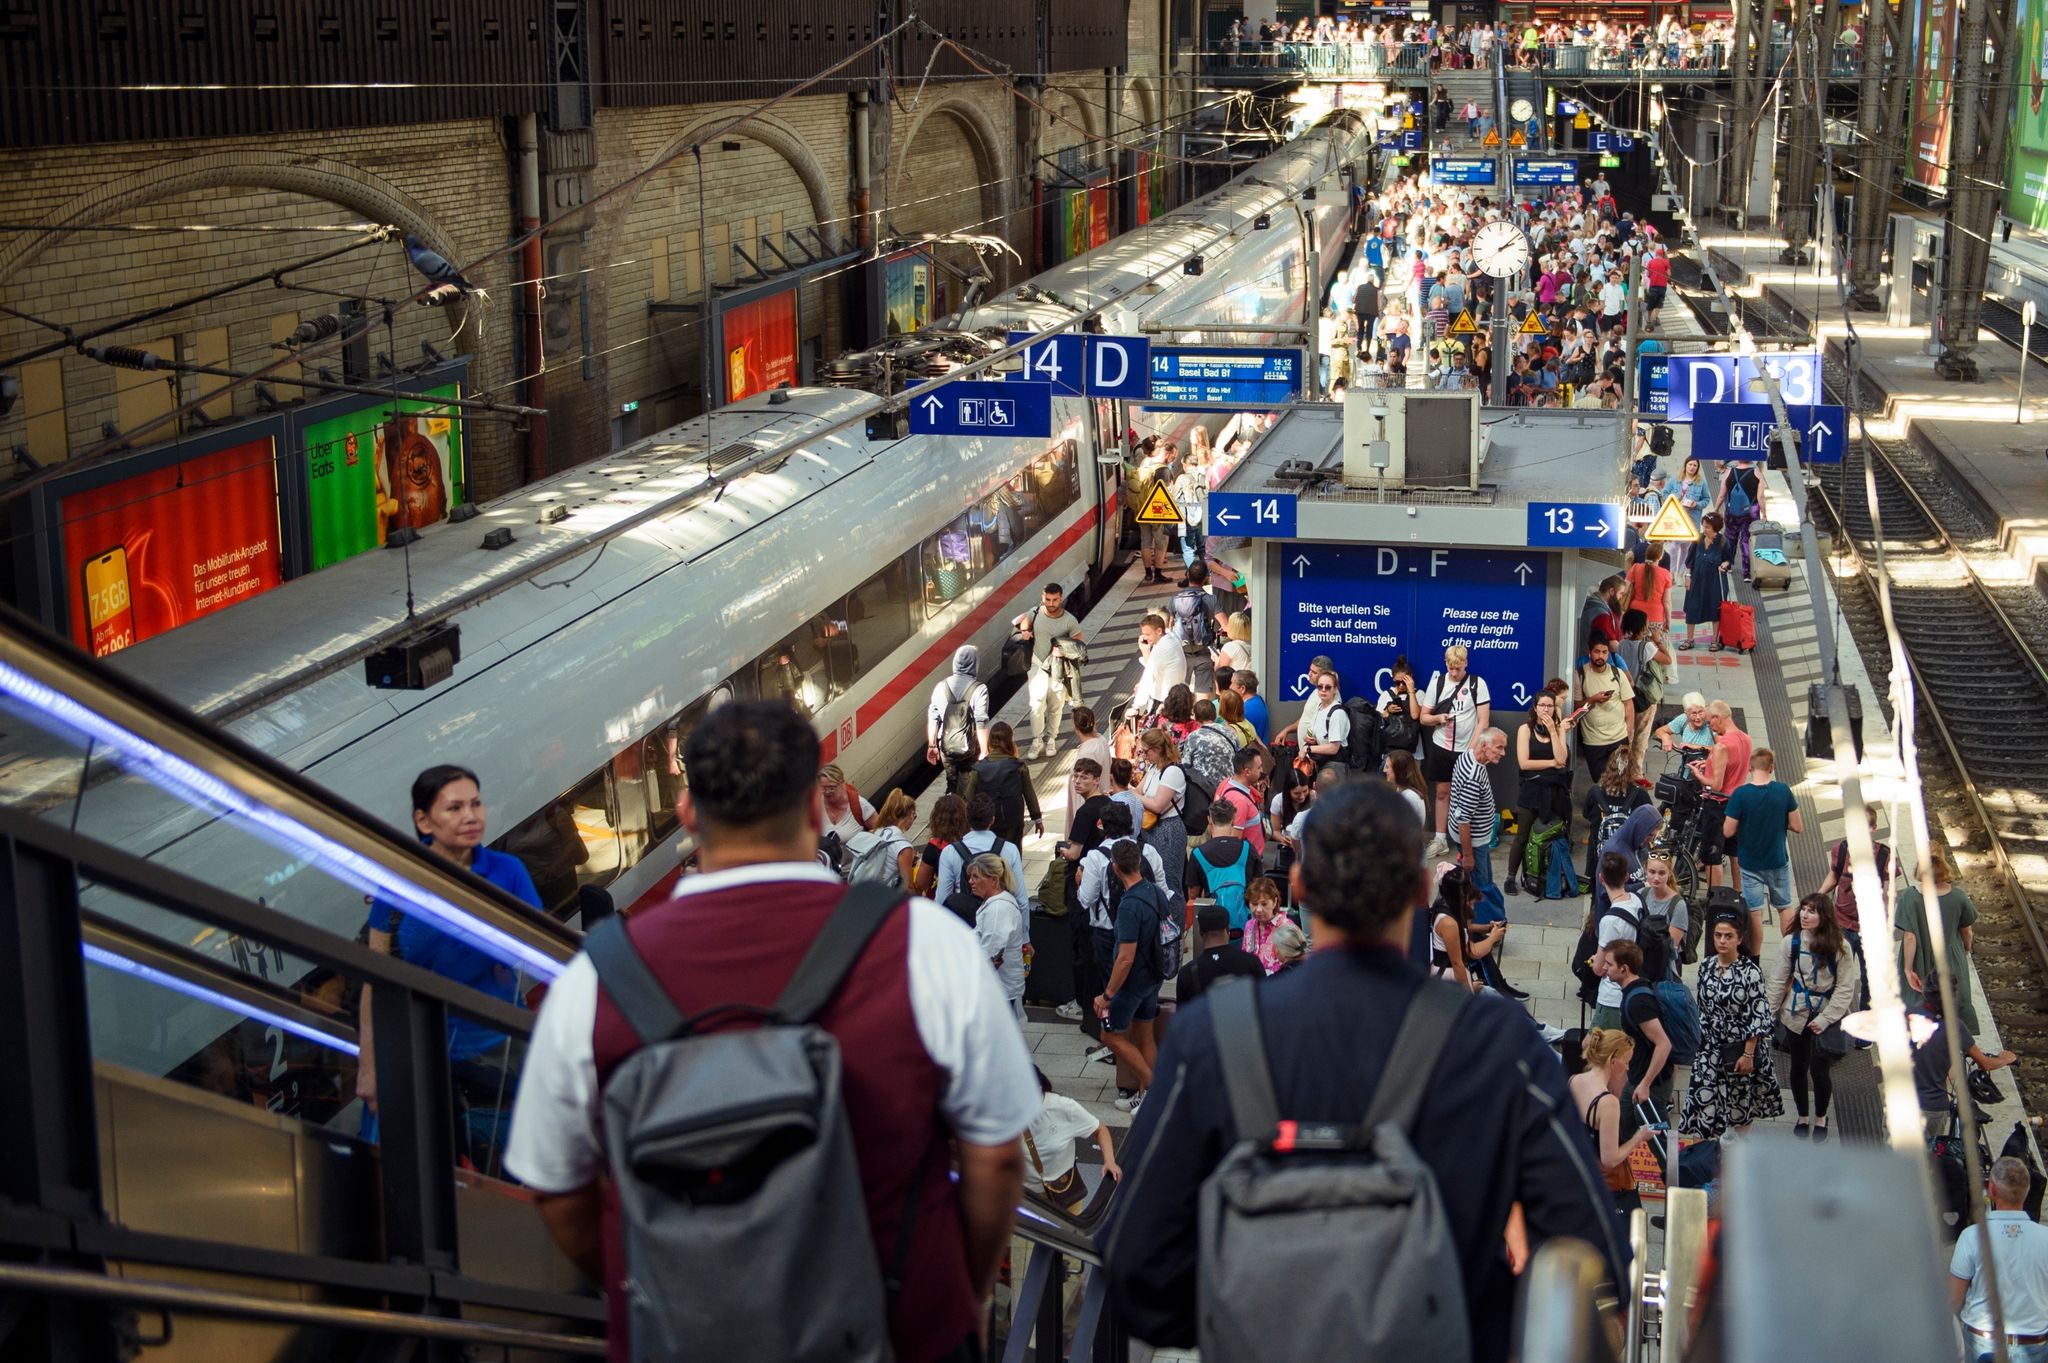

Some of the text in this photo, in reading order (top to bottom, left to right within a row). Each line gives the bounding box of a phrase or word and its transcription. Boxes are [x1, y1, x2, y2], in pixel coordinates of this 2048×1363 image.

[1405, 132, 1415, 148] E
[1596, 134, 1606, 150] E
[1023, 340, 1128, 388] 14 D
[1152, 356, 1169, 372] 14
[1179, 368, 1230, 377] Basel Bad Bf
[1688, 362, 1725, 410] D
[311, 442, 333, 460] Uber
[312, 460, 335, 479] Eats
[1251, 499, 1280, 524] 14
[1544, 508, 1574, 534] 13
[1377, 548, 1398, 575] D
[1431, 550, 1448, 577] F
[193, 564, 206, 578] Das
[194, 564, 250, 594] für unsere treuen
[1299, 602, 1390, 616] Bitte verteilen Sie
[1442, 608, 1519, 620] Please use the
[1310, 618, 1377, 630] sich auf dem
[1447, 623, 1514, 637] entire length
[1291, 632, 1397, 647] gesamten Bahnsteig
[1441, 637, 1518, 650] of the platform
[265, 1024, 288, 1082] 2
[292, 1081, 298, 1098] 9
